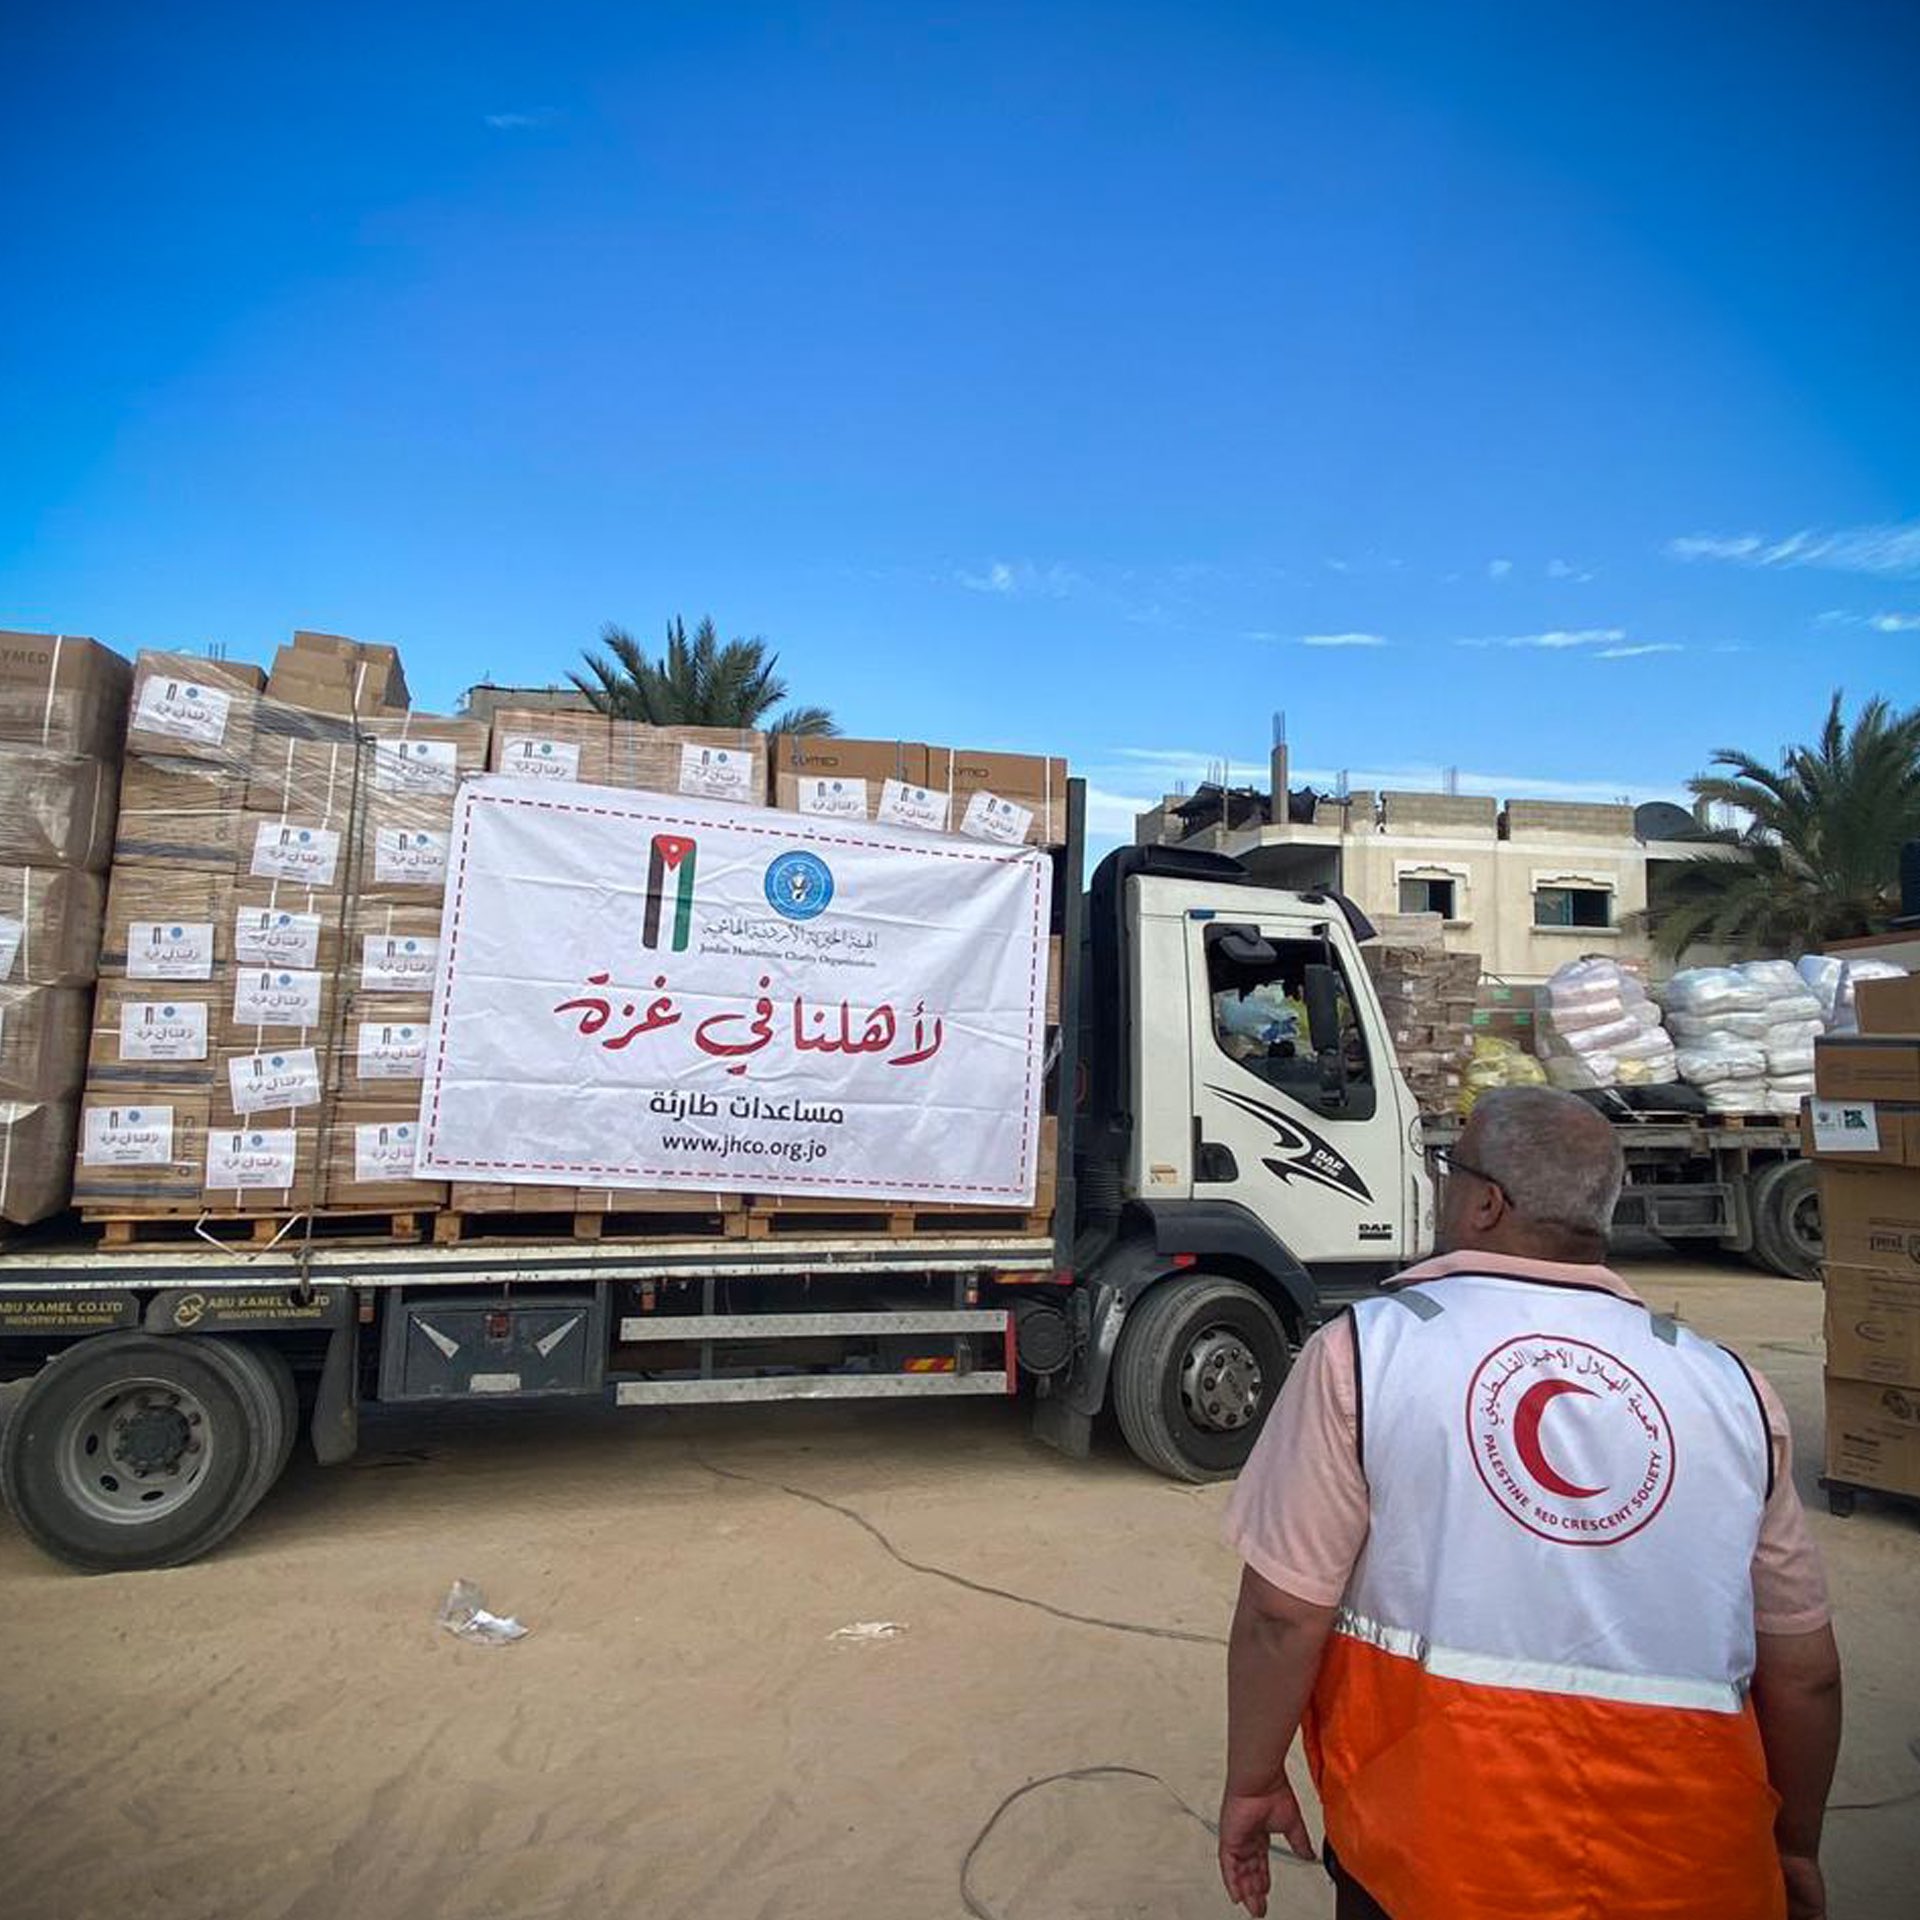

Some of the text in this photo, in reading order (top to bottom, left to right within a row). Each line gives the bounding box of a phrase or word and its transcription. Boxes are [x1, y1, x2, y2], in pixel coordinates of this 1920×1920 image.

[554, 974, 942, 1074] لأهلنا في غزة
[650, 1090, 844, 1124] مساعدات طارئة
[662, 1135, 827, 1162] www.jhco.org.jo
[26, 1302, 74, 1313] KAMEL
[239, 1295, 283, 1307] KAMEL
[1576, 1355, 1631, 1393] الهلال
[1483, 1434, 1663, 1531] PALESTINE RED CRESCENT SOCIETY
